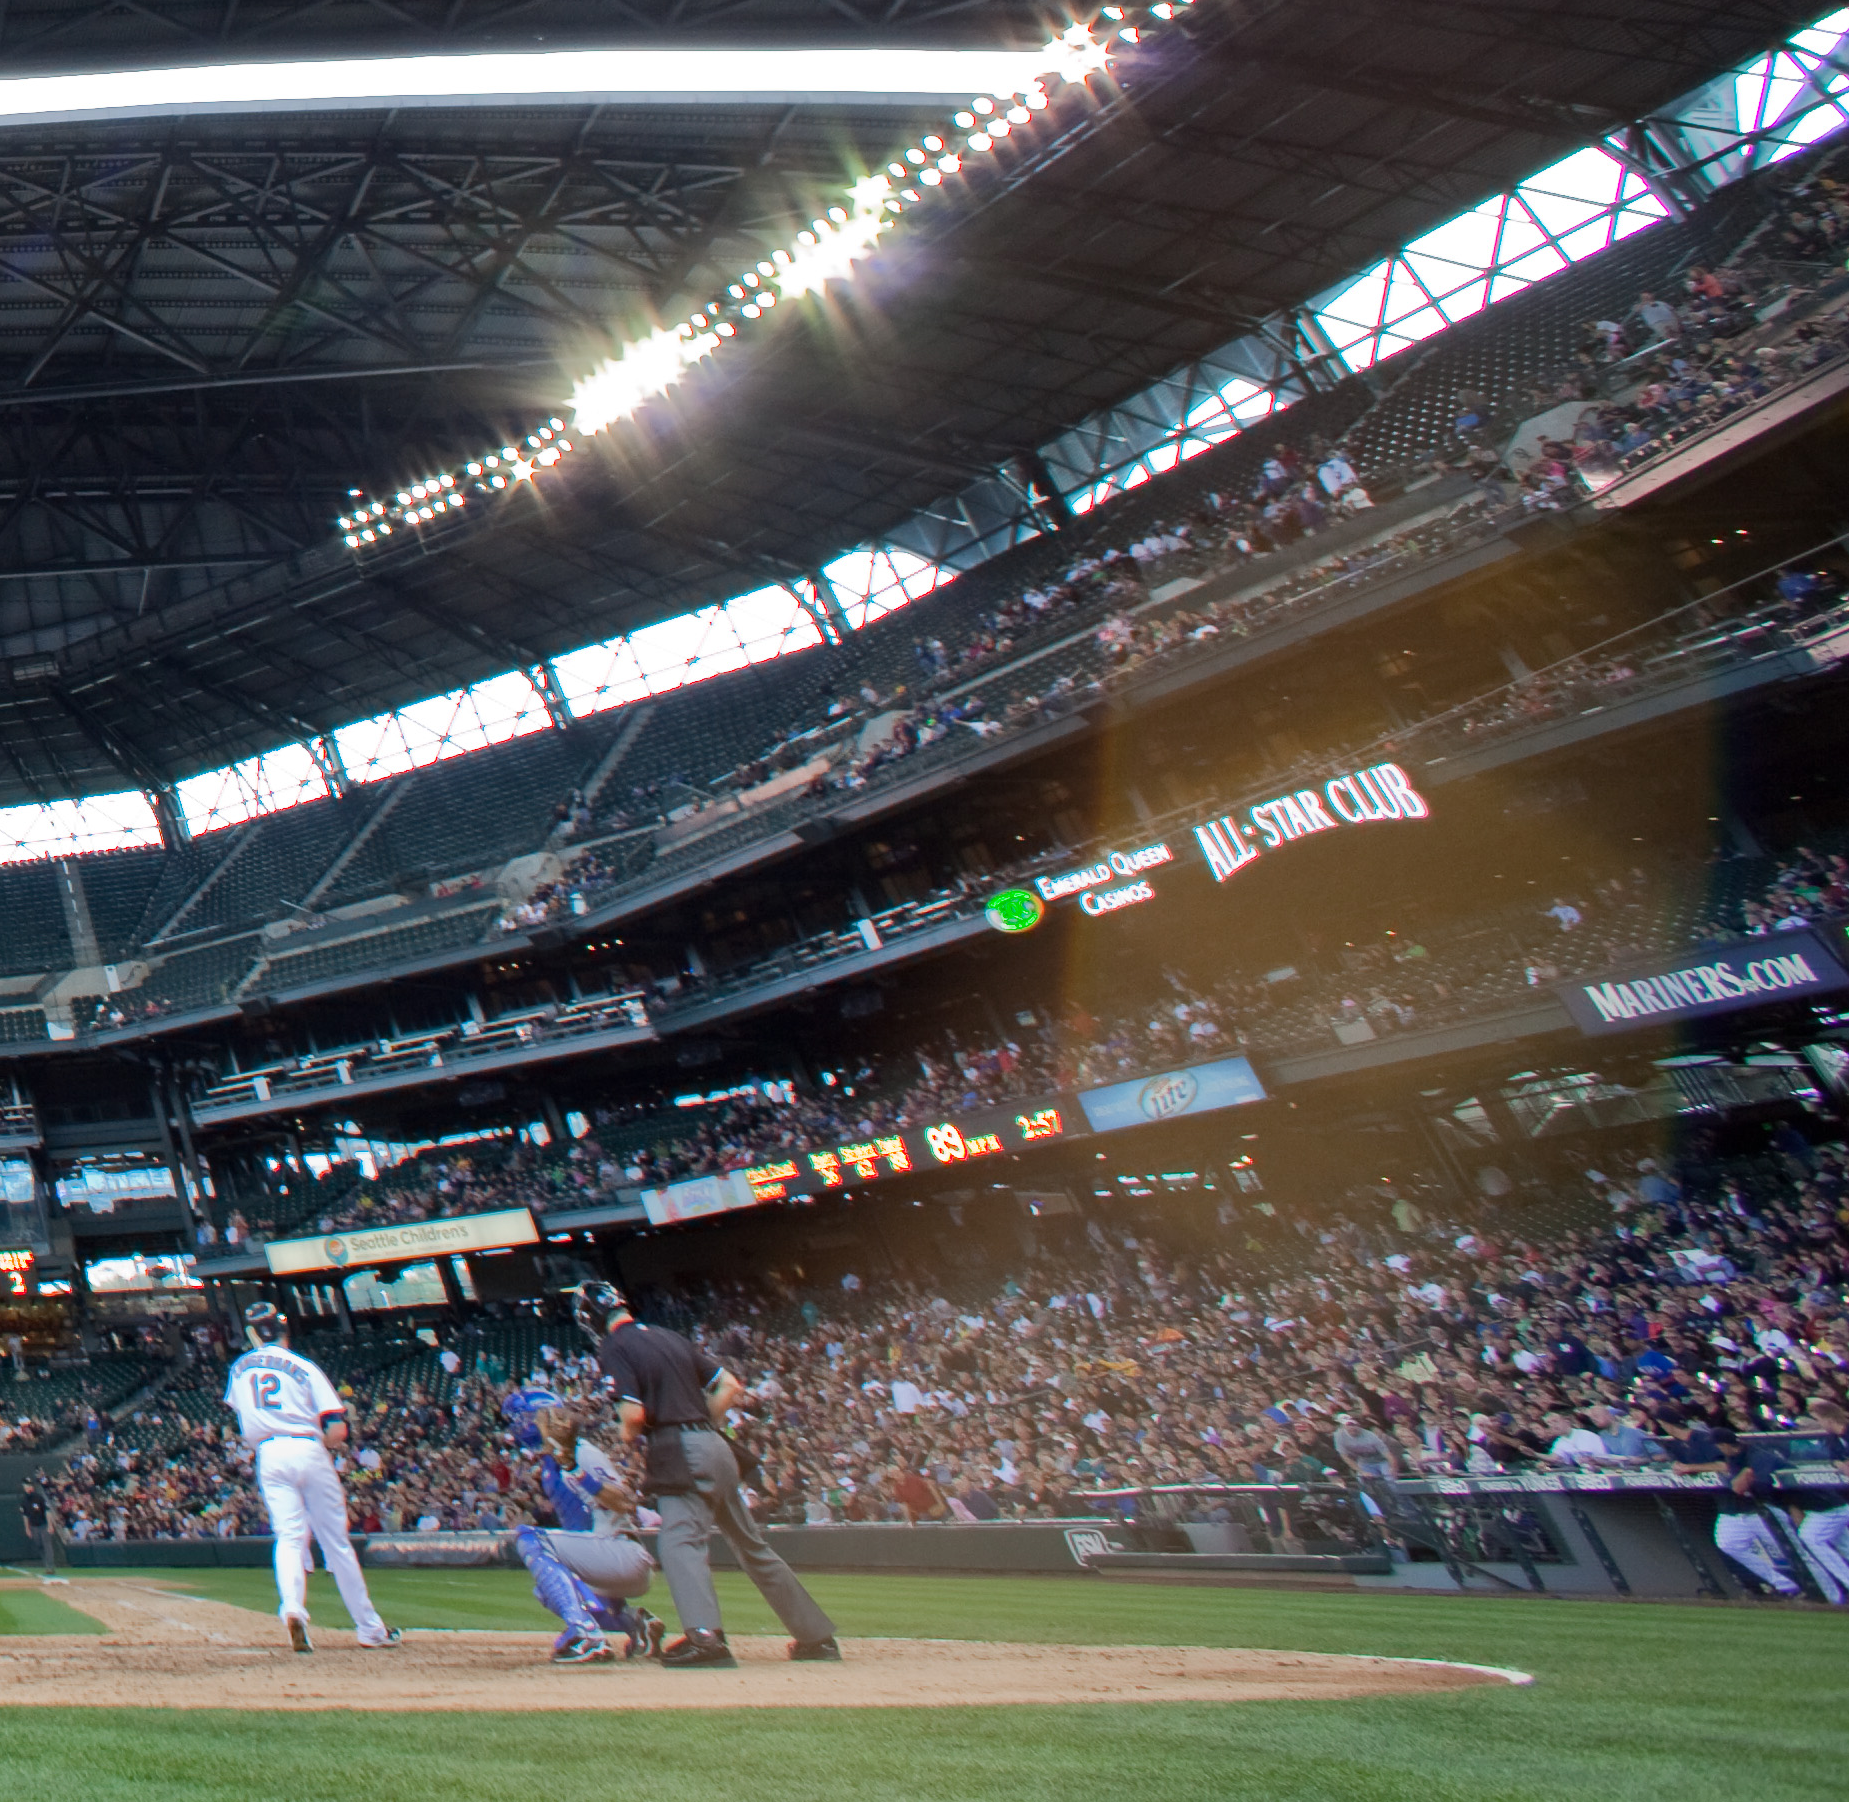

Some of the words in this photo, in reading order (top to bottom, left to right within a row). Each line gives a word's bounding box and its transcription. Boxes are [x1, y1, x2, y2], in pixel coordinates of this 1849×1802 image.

[1325, 762, 1430, 823] CLUB
[1583, 953, 1819, 1022] MARINERS.COM
[925, 1122, 966, 1164] 89
[1016, 1109, 1063, 1141] 2:57
[350, 1231, 398, 1251] Seattle
[400, 1224, 469, 1248] Children's
[9, 1272, 27, 1295] 2
[249, 1373, 281, 1410] 12
